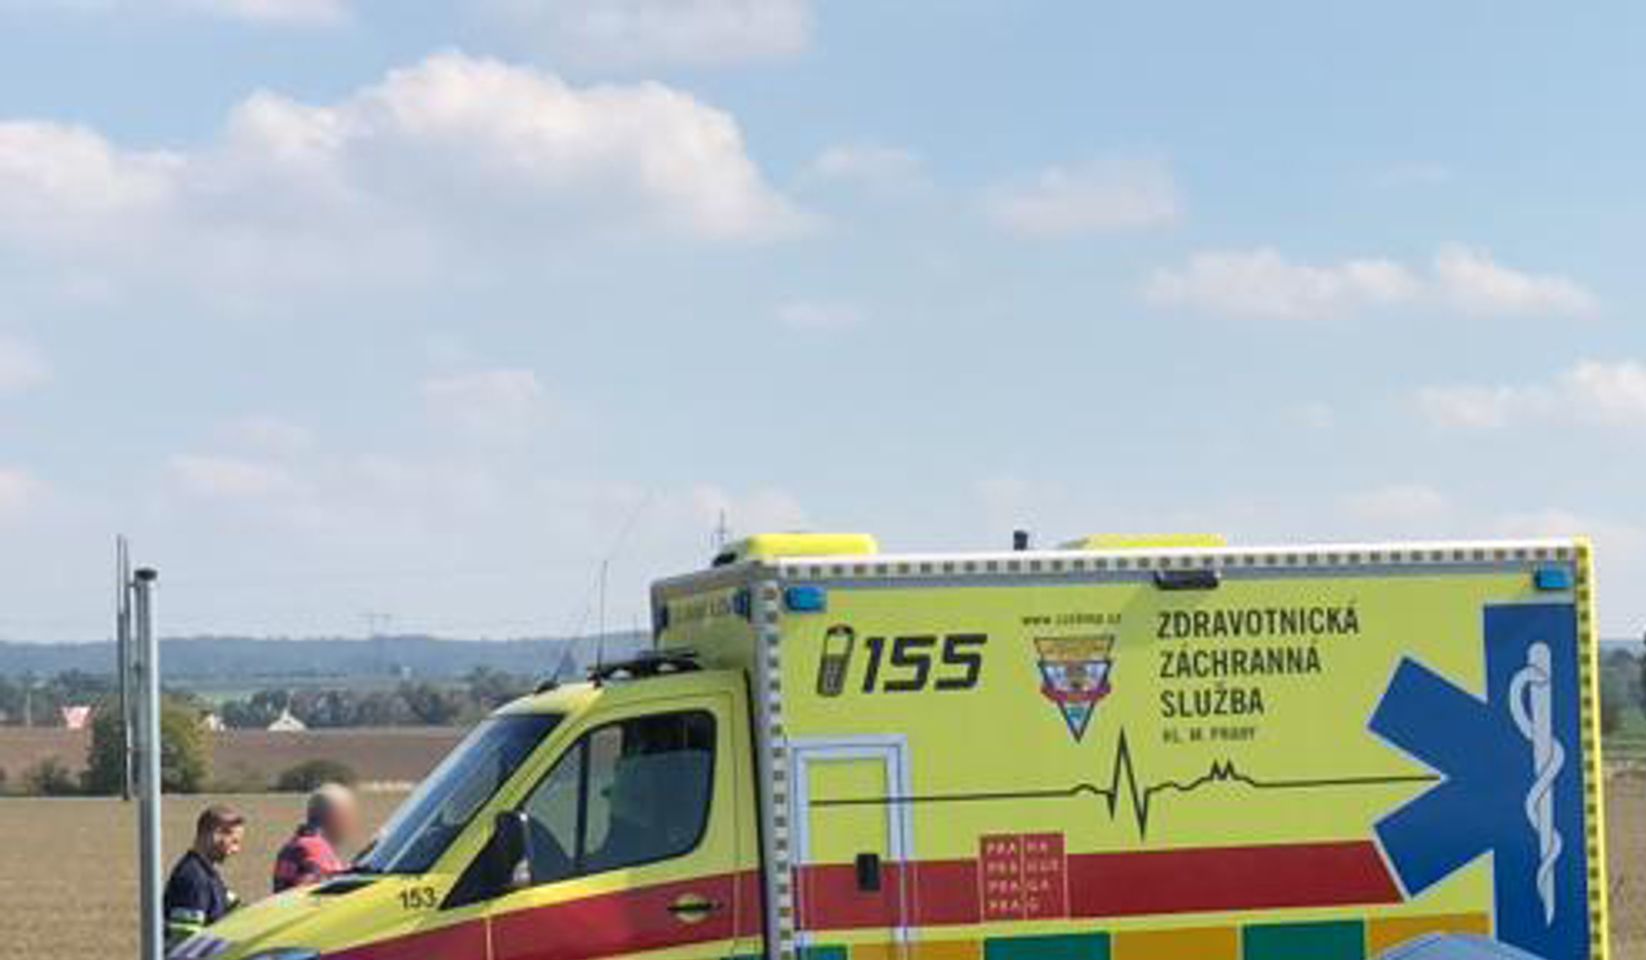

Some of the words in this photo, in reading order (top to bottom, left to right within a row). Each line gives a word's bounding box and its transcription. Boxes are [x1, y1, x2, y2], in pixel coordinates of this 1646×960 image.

[1156, 601, 1360, 639] ZDRAVOTNICKÁ
[861, 633, 988, 694] 155
[1159, 638, 1322, 679] ZÁCHRANNÁ
[1159, 682, 1265, 718] SLUŽBA
[399, 886, 438, 910] 153
